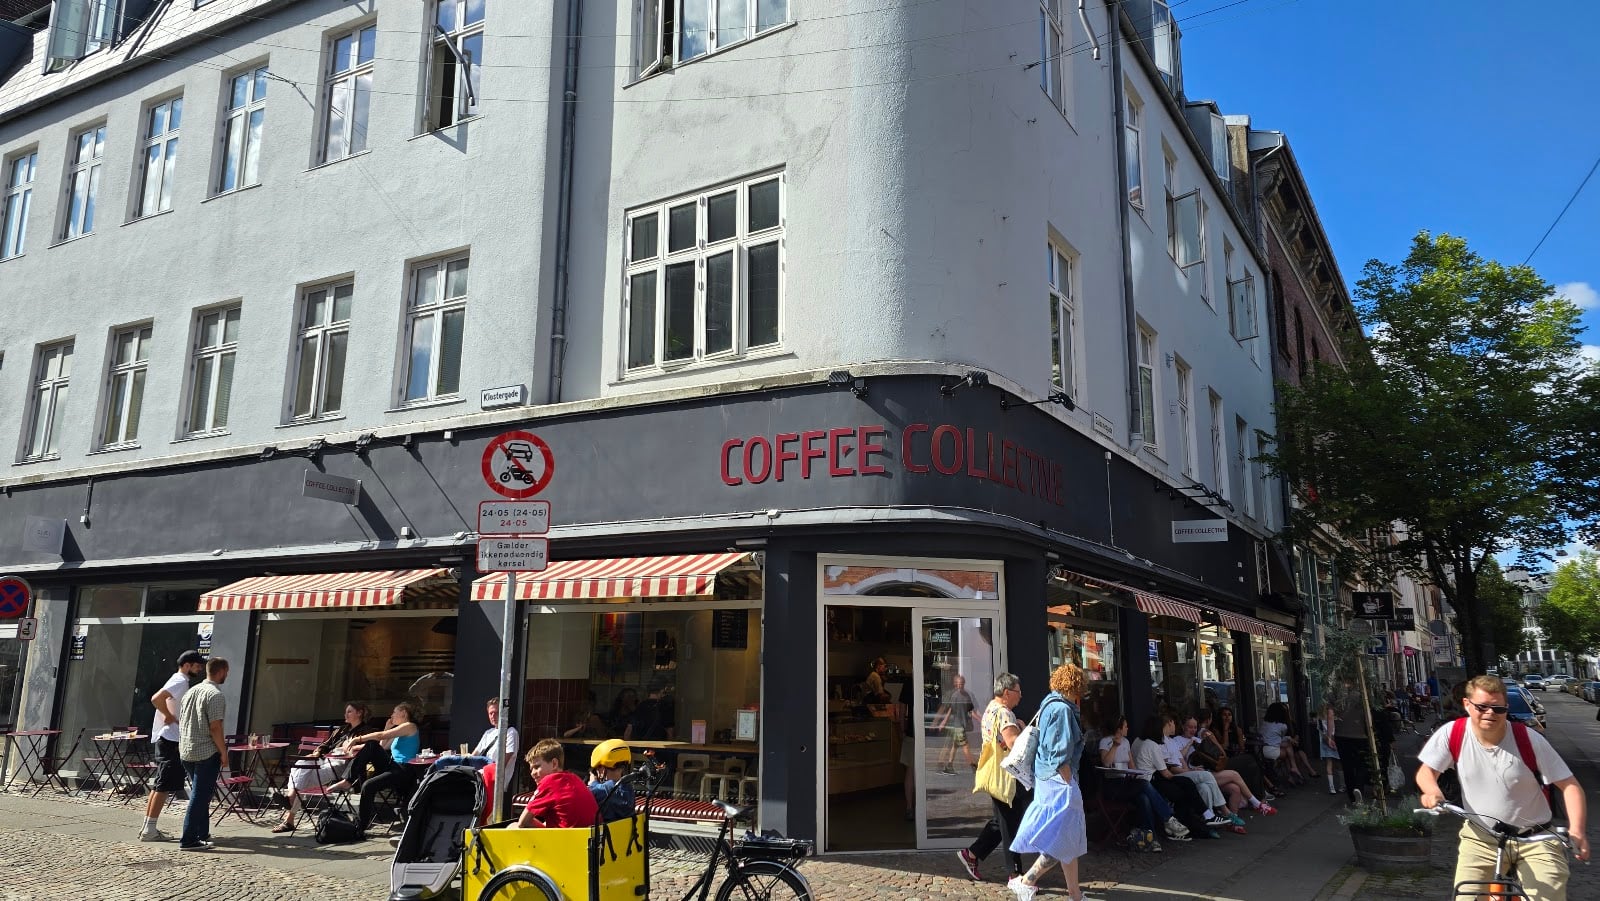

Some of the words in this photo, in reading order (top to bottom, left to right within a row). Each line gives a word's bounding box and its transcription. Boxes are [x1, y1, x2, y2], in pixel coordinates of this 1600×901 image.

[483, 390, 519, 402] Klostergade
[720, 424, 885, 485] COFFEE
[902, 423, 1064, 507] COLLECTIVE
[305, 480, 326, 490] COFFEE
[481, 550, 544, 559] ikkenødvendig
[498, 560, 526, 568] kørsel
